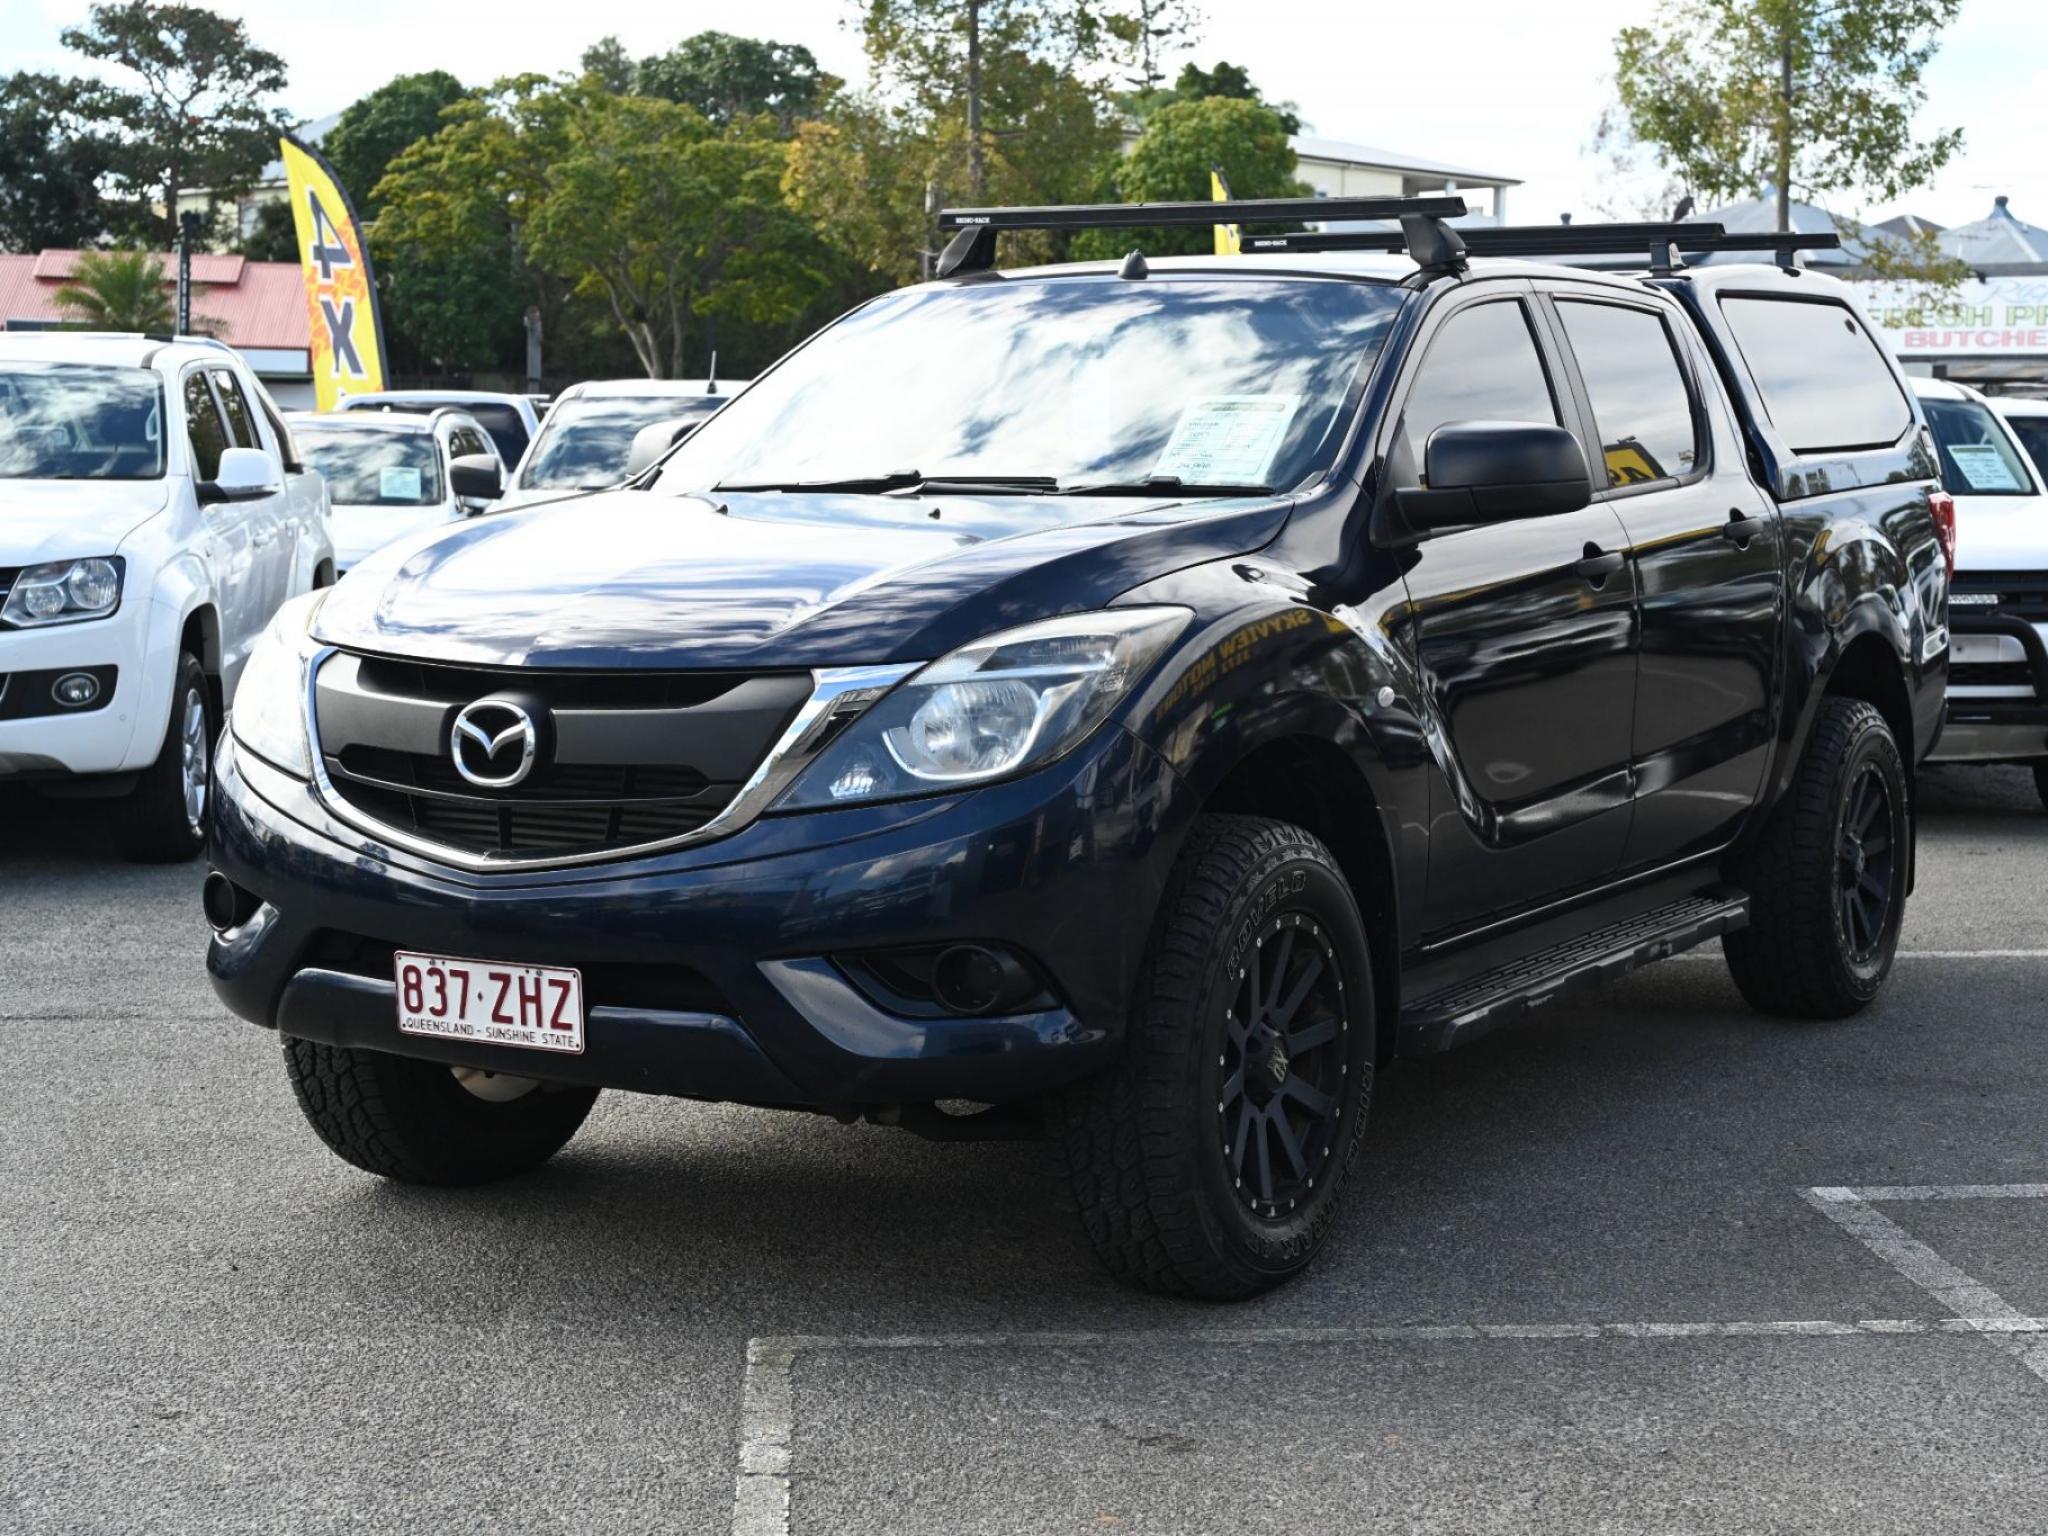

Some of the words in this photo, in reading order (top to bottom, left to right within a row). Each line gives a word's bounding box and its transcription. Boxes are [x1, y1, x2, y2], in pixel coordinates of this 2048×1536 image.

[309, 189, 364, 396] 4X
[406, 1016, 474, 1036] QUEENSLAND
[485, 1026, 536, 1043] SUNSHINE
[541, 1033, 575, 1048] STATE
